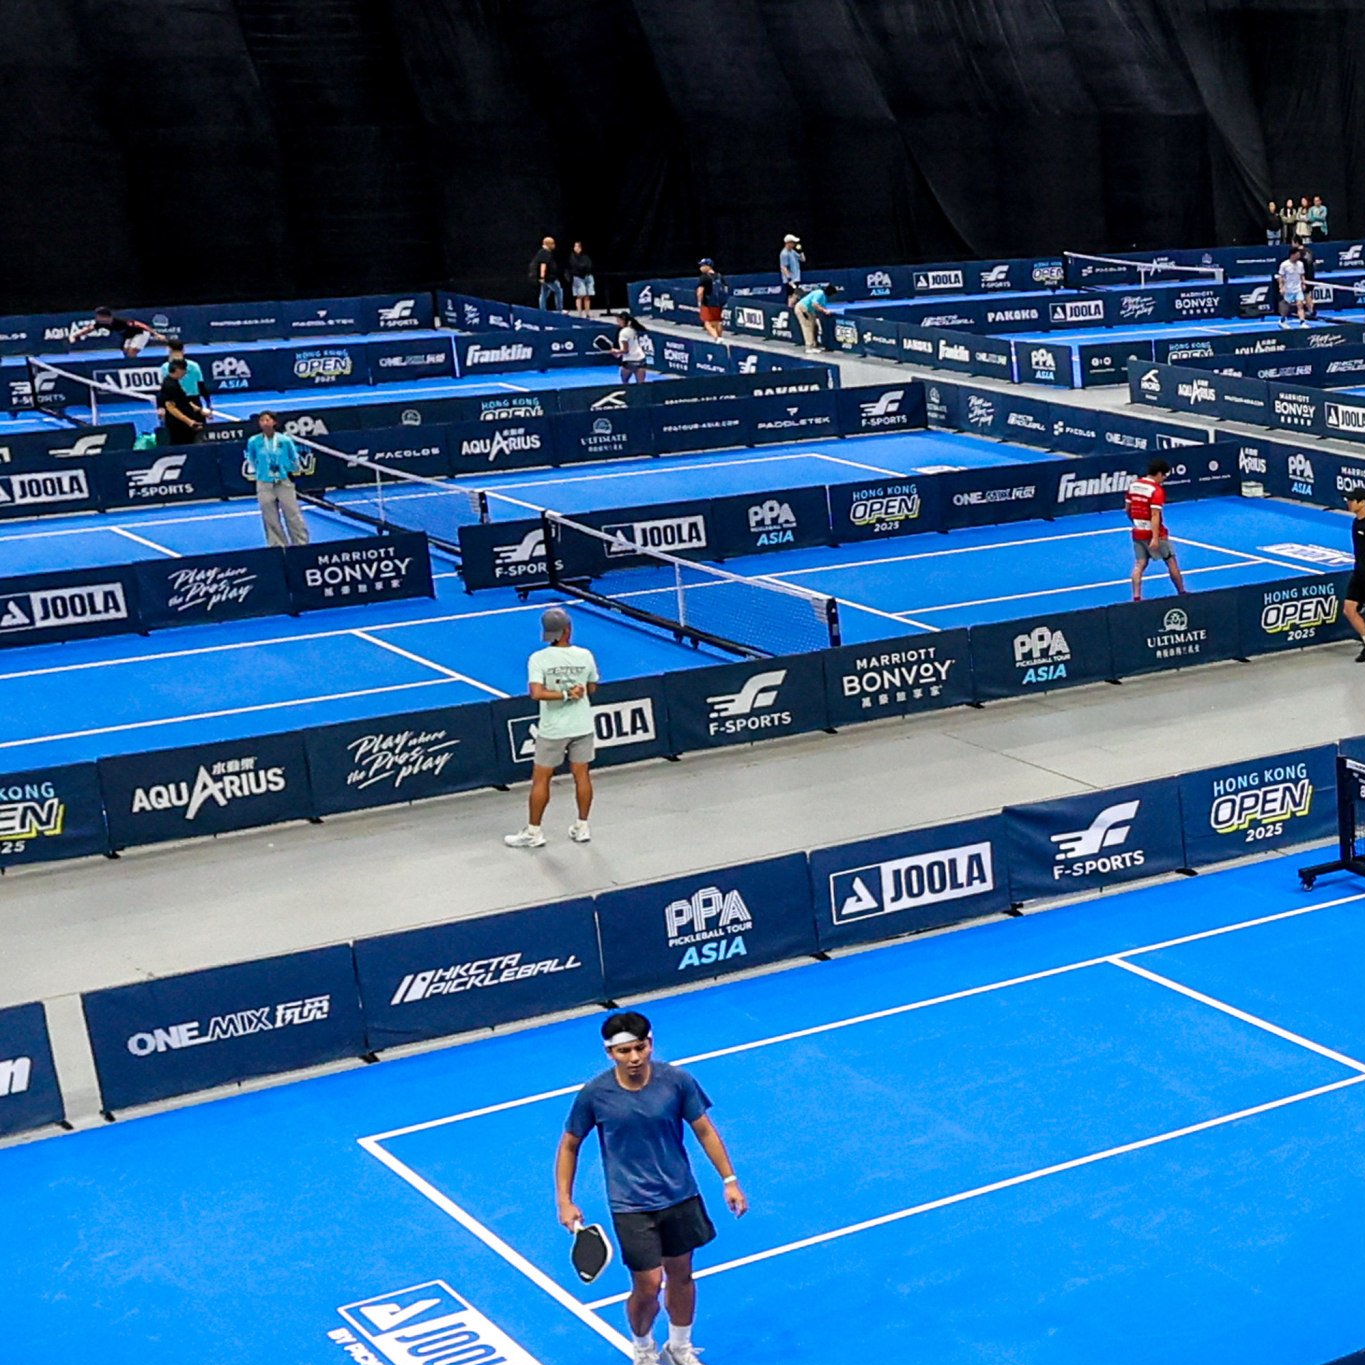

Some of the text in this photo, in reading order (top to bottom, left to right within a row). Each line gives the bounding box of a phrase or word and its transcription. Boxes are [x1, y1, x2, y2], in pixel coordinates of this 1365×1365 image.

[932, 274, 961, 286] JOOLA
[987, 309, 1038, 322] PAKOKO
[1067, 304, 1101, 318] JOOLA
[212, 357, 250, 378] PPA
[1031, 349, 1056, 368] PPA
[218, 379, 248, 388] ASIA
[758, 416, 830, 429] PADDLETEK
[862, 414, 907, 426] F-SPORTS
[461, 430, 540, 462] AQUARIUS
[18, 474, 84, 500] JOOLA
[128, 483, 194, 498] F-SPORTS
[853, 484, 916, 501] HONG KONG
[748, 500, 796, 524] PPA
[851, 495, 920, 525] OPEN
[638, 521, 701, 547] JOOLA
[756, 529, 794, 546] ASIA
[874, 522, 899, 532] 2025
[318, 547, 395, 565] MARRIOTT
[305, 558, 413, 587] BONVOY
[40, 589, 120, 621] JOOLA
[1264, 583, 1335, 605] HONG KONG
[1261, 596, 1338, 633] OPEN
[1014, 626, 1070, 661] PPA
[1147, 630, 1206, 648] ULTIMATE
[1287, 628, 1315, 641] 2025
[856, 647, 936, 670] MARRIOTT
[843, 659, 953, 697] BONVOY
[1022, 664, 1067, 684] ASIA
[709, 711, 792, 736] F-SPORTS
[132, 764, 286, 820] AQUARIUS
[1213, 763, 1308, 797] HONG KONG
[1210, 779, 1313, 833] OPEN
[1246, 822, 1283, 843] 2025
[1053, 849, 1144, 880] F-SPORTS
[889, 852, 988, 904] JOOLA
[665, 886, 752, 938] PPA
[668, 920, 753, 947] PICKLEBALL TOUR
[678, 935, 747, 970] ASIA
[425, 954, 582, 996] PICKLEBALL
[430, 952, 522, 982] HKCTA
